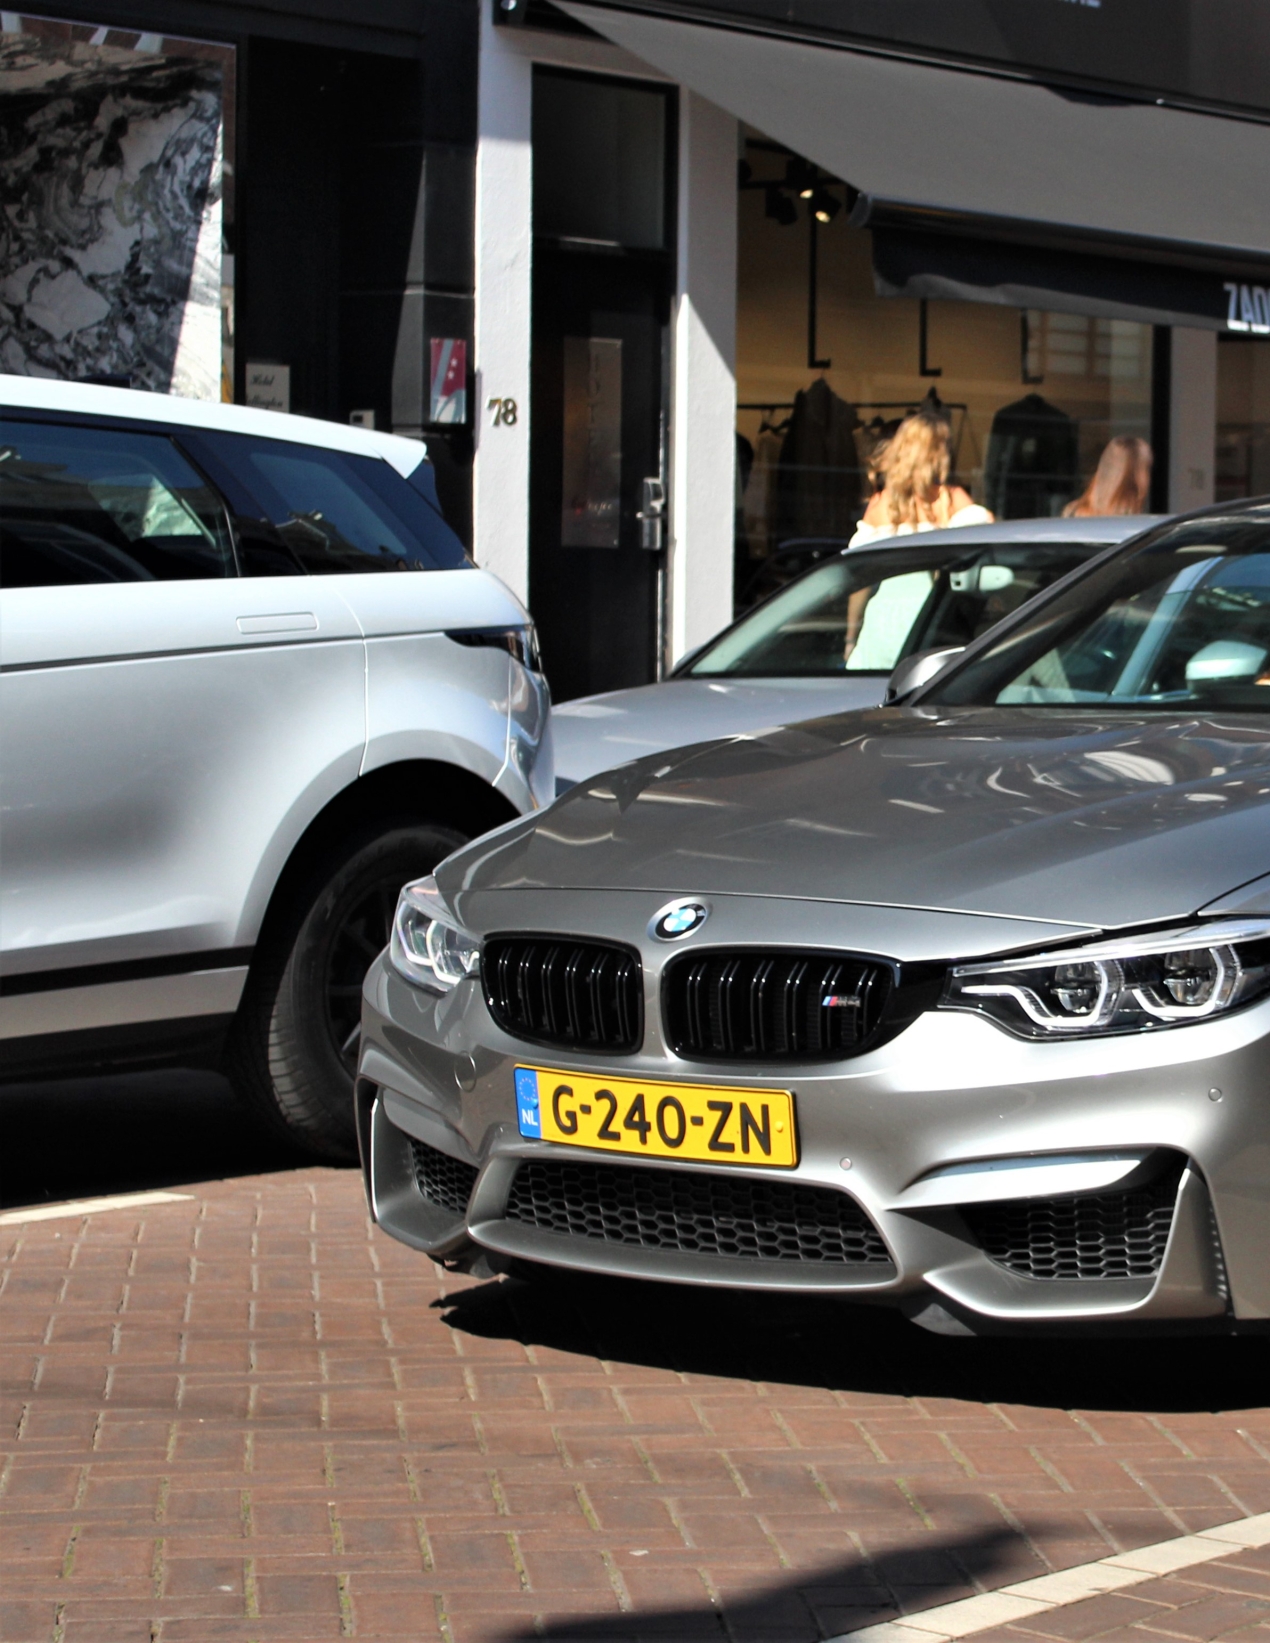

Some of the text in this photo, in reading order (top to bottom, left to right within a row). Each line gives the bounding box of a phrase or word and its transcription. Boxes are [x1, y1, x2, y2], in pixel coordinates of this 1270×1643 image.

[485, 397, 518, 428] 78
[521, 1108, 538, 1126] NL
[552, 1084, 771, 1156] G-240-ZN
